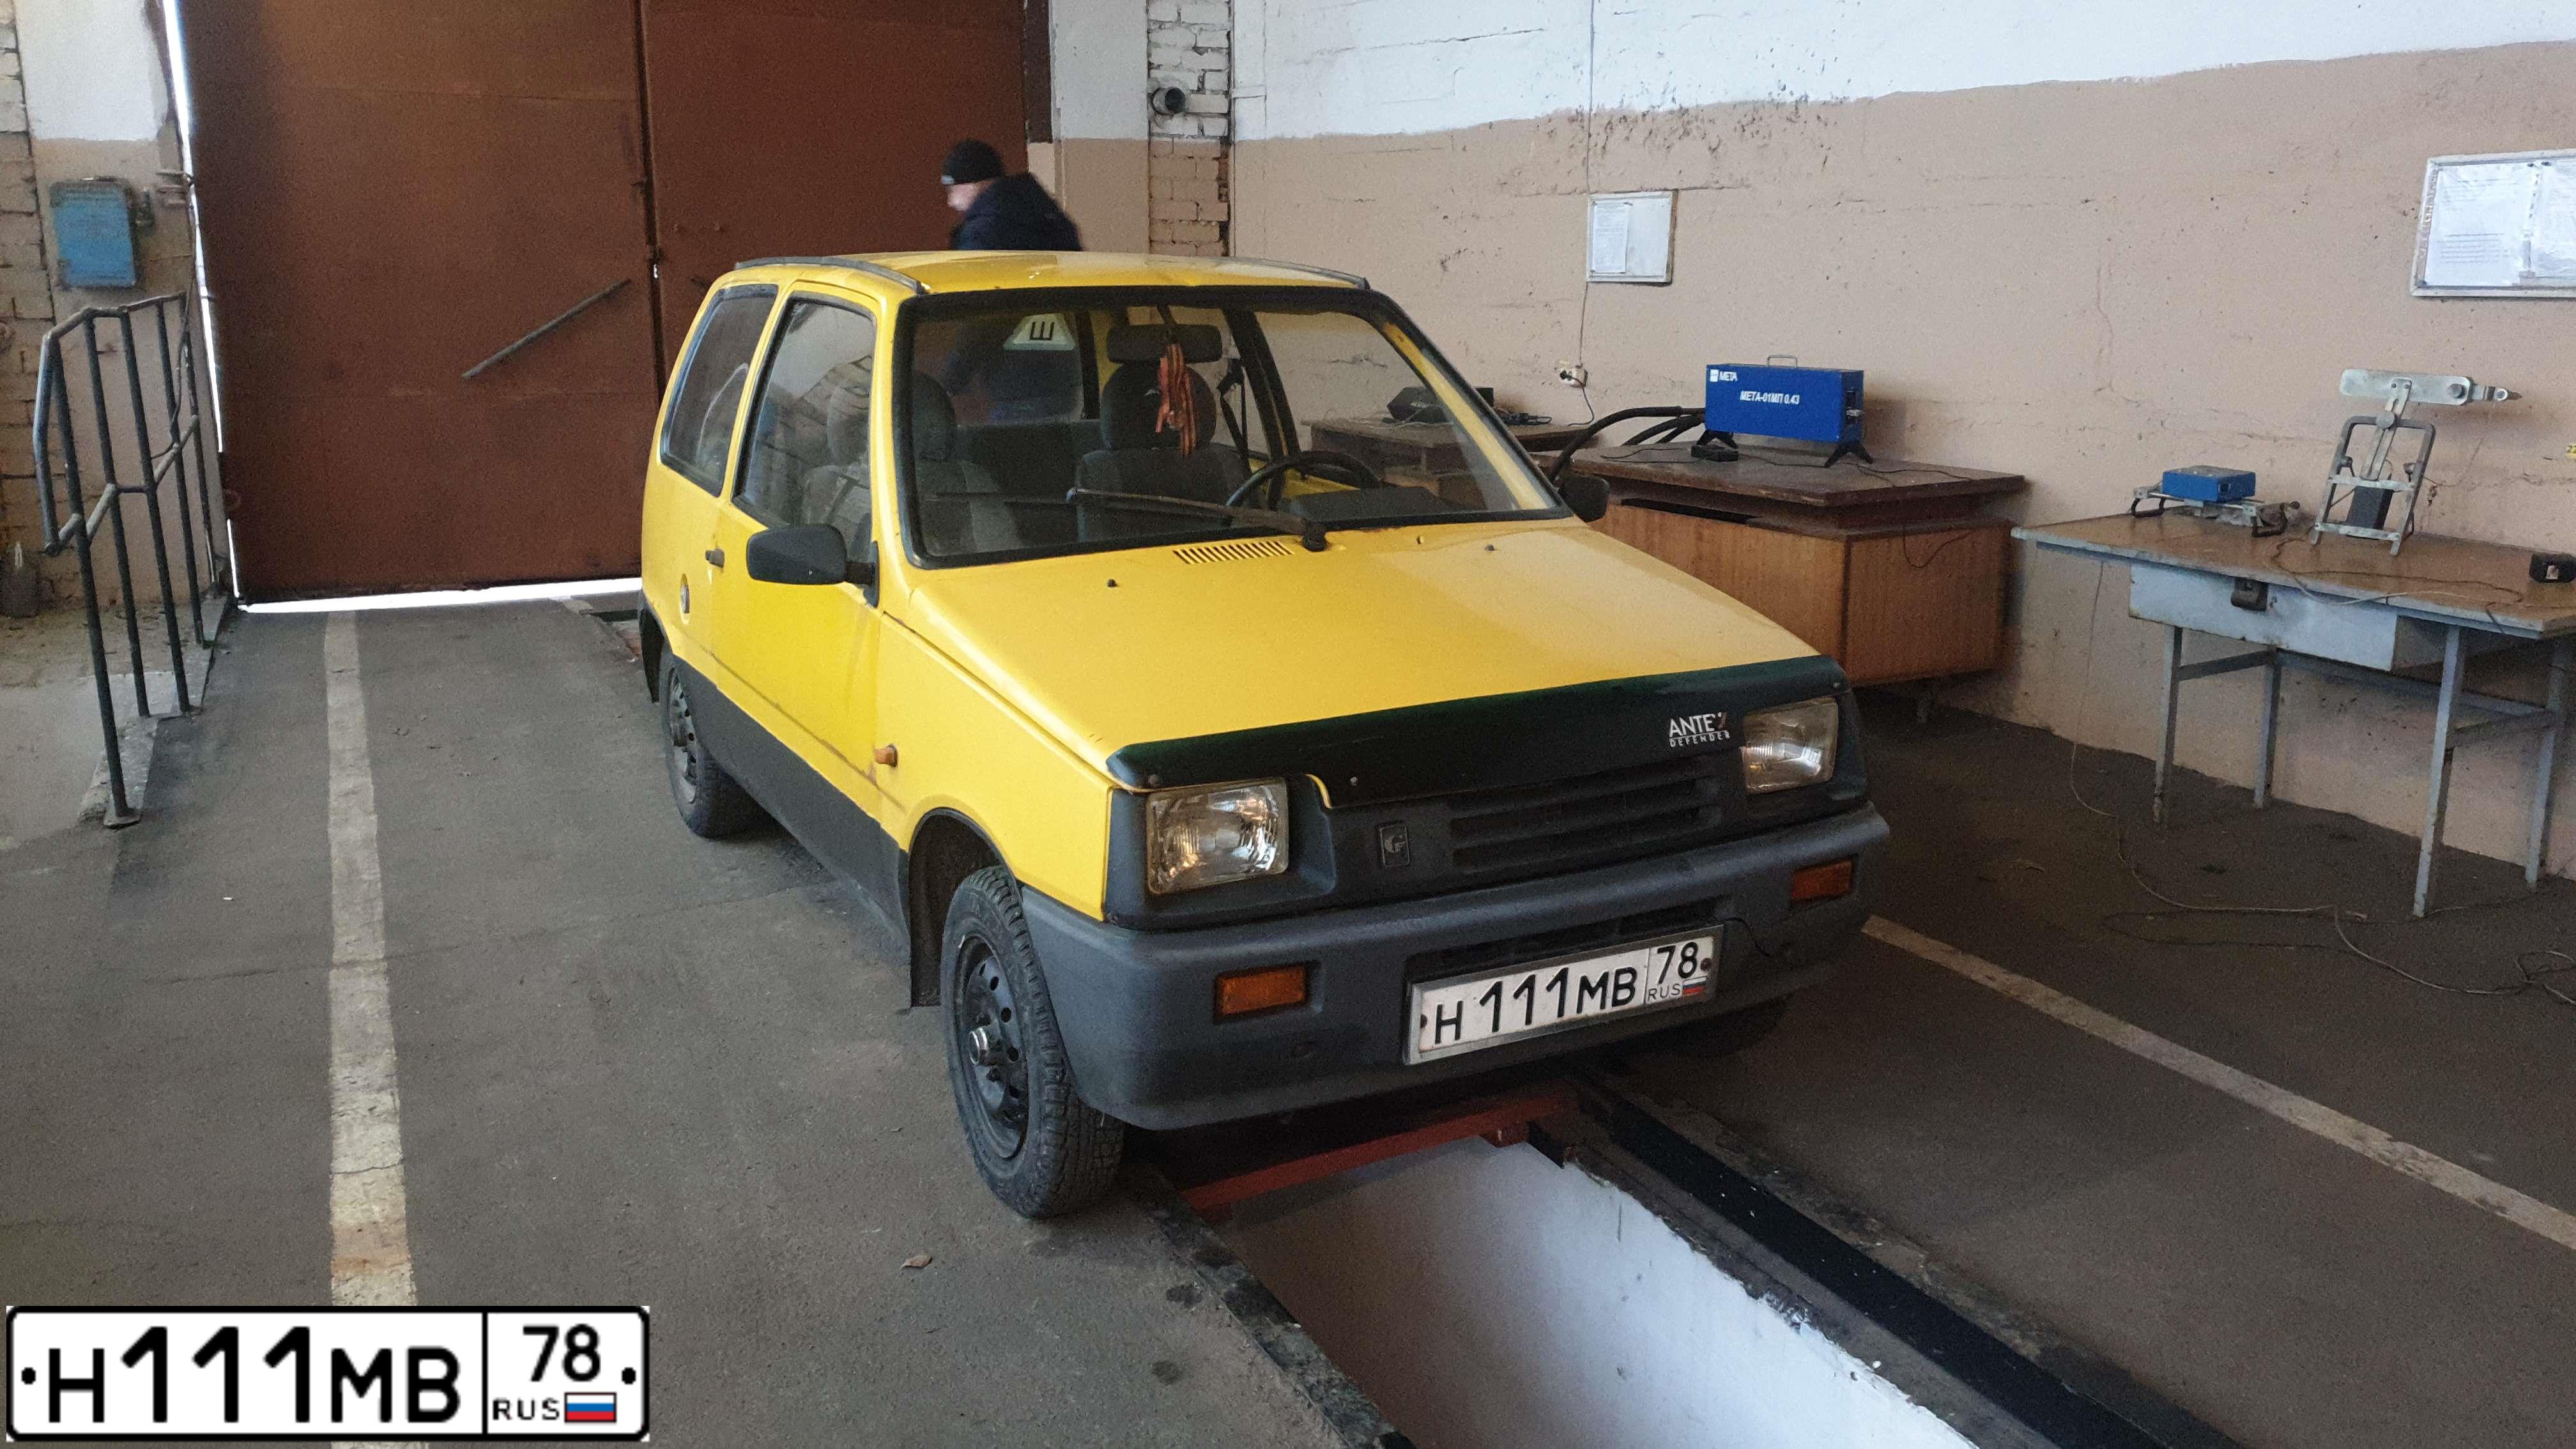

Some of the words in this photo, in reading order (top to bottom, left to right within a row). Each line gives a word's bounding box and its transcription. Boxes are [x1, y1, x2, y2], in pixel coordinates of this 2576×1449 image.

[1029, 321, 1055, 341] Ш
[1669, 730, 1731, 747] DEFENDER
[1657, 942, 1699, 984] 78
[1648, 983, 1682, 1002] RUS
